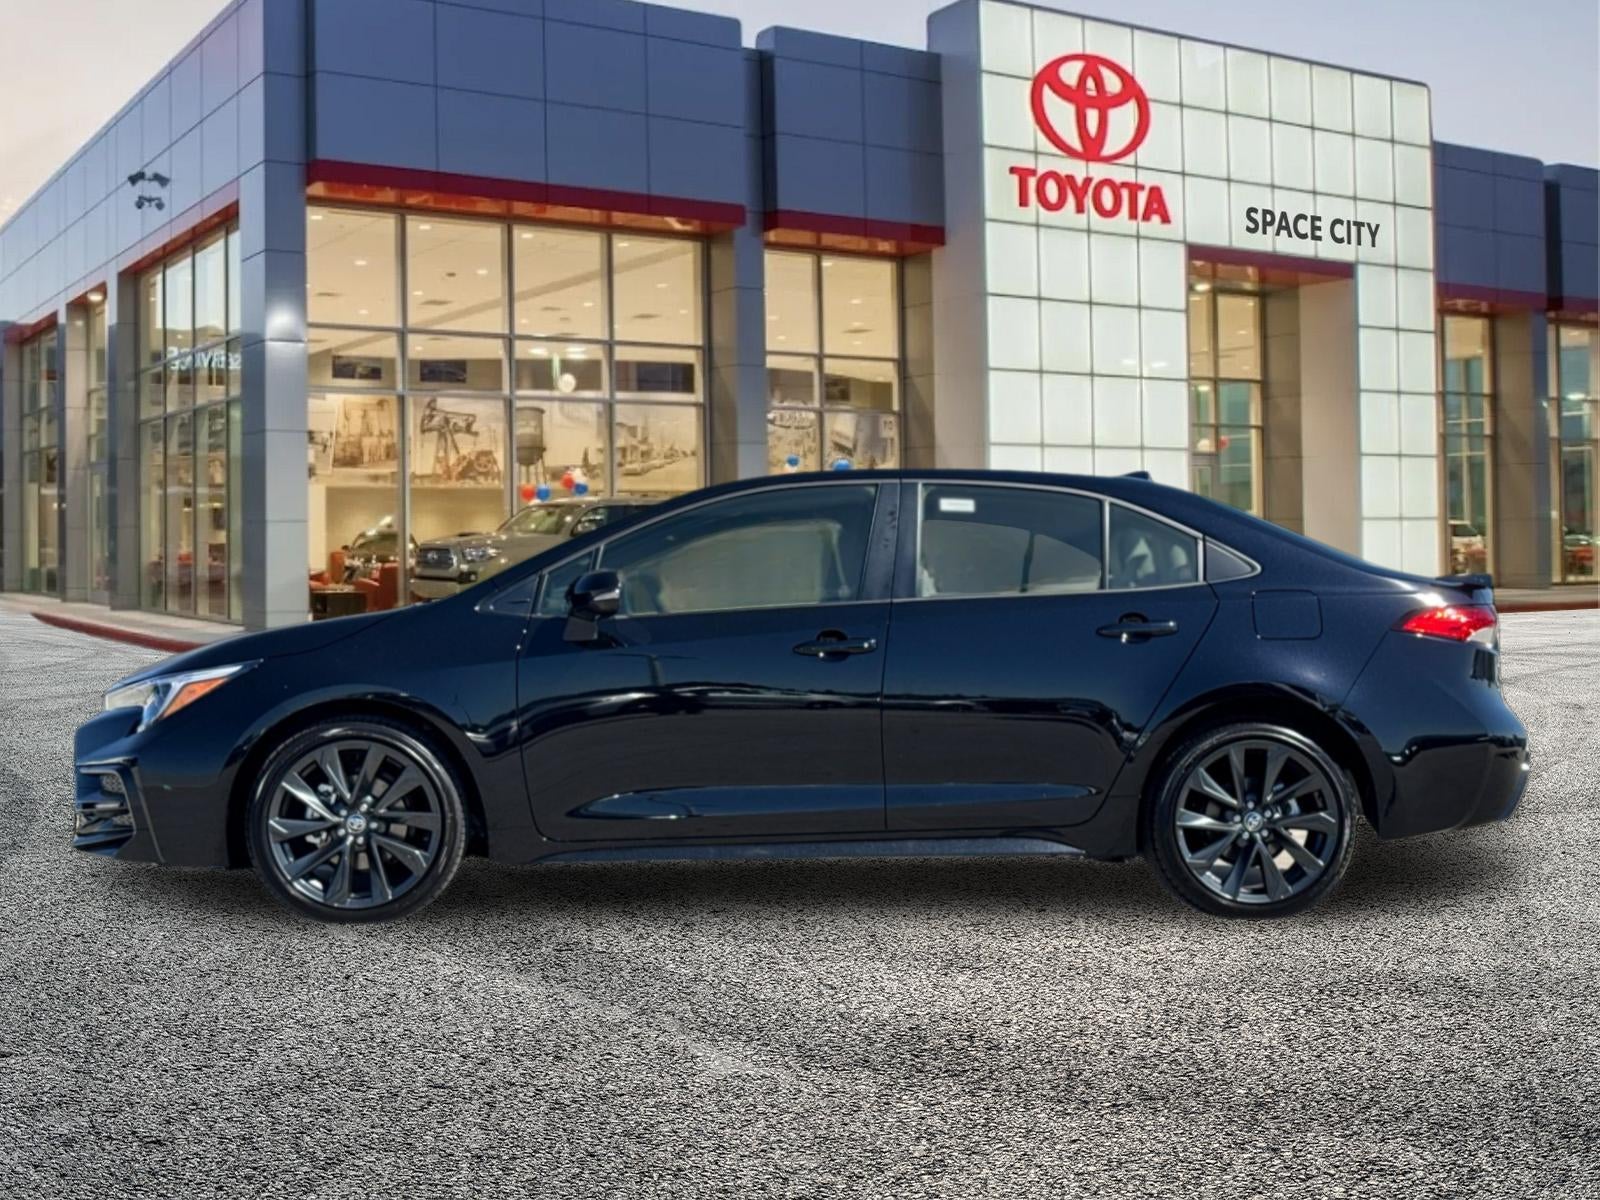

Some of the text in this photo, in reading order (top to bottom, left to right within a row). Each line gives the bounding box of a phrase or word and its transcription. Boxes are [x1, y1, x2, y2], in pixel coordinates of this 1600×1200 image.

[1009, 166, 1171, 224] TOYOTA
[1245, 206, 1381, 248] SPACE CITY
